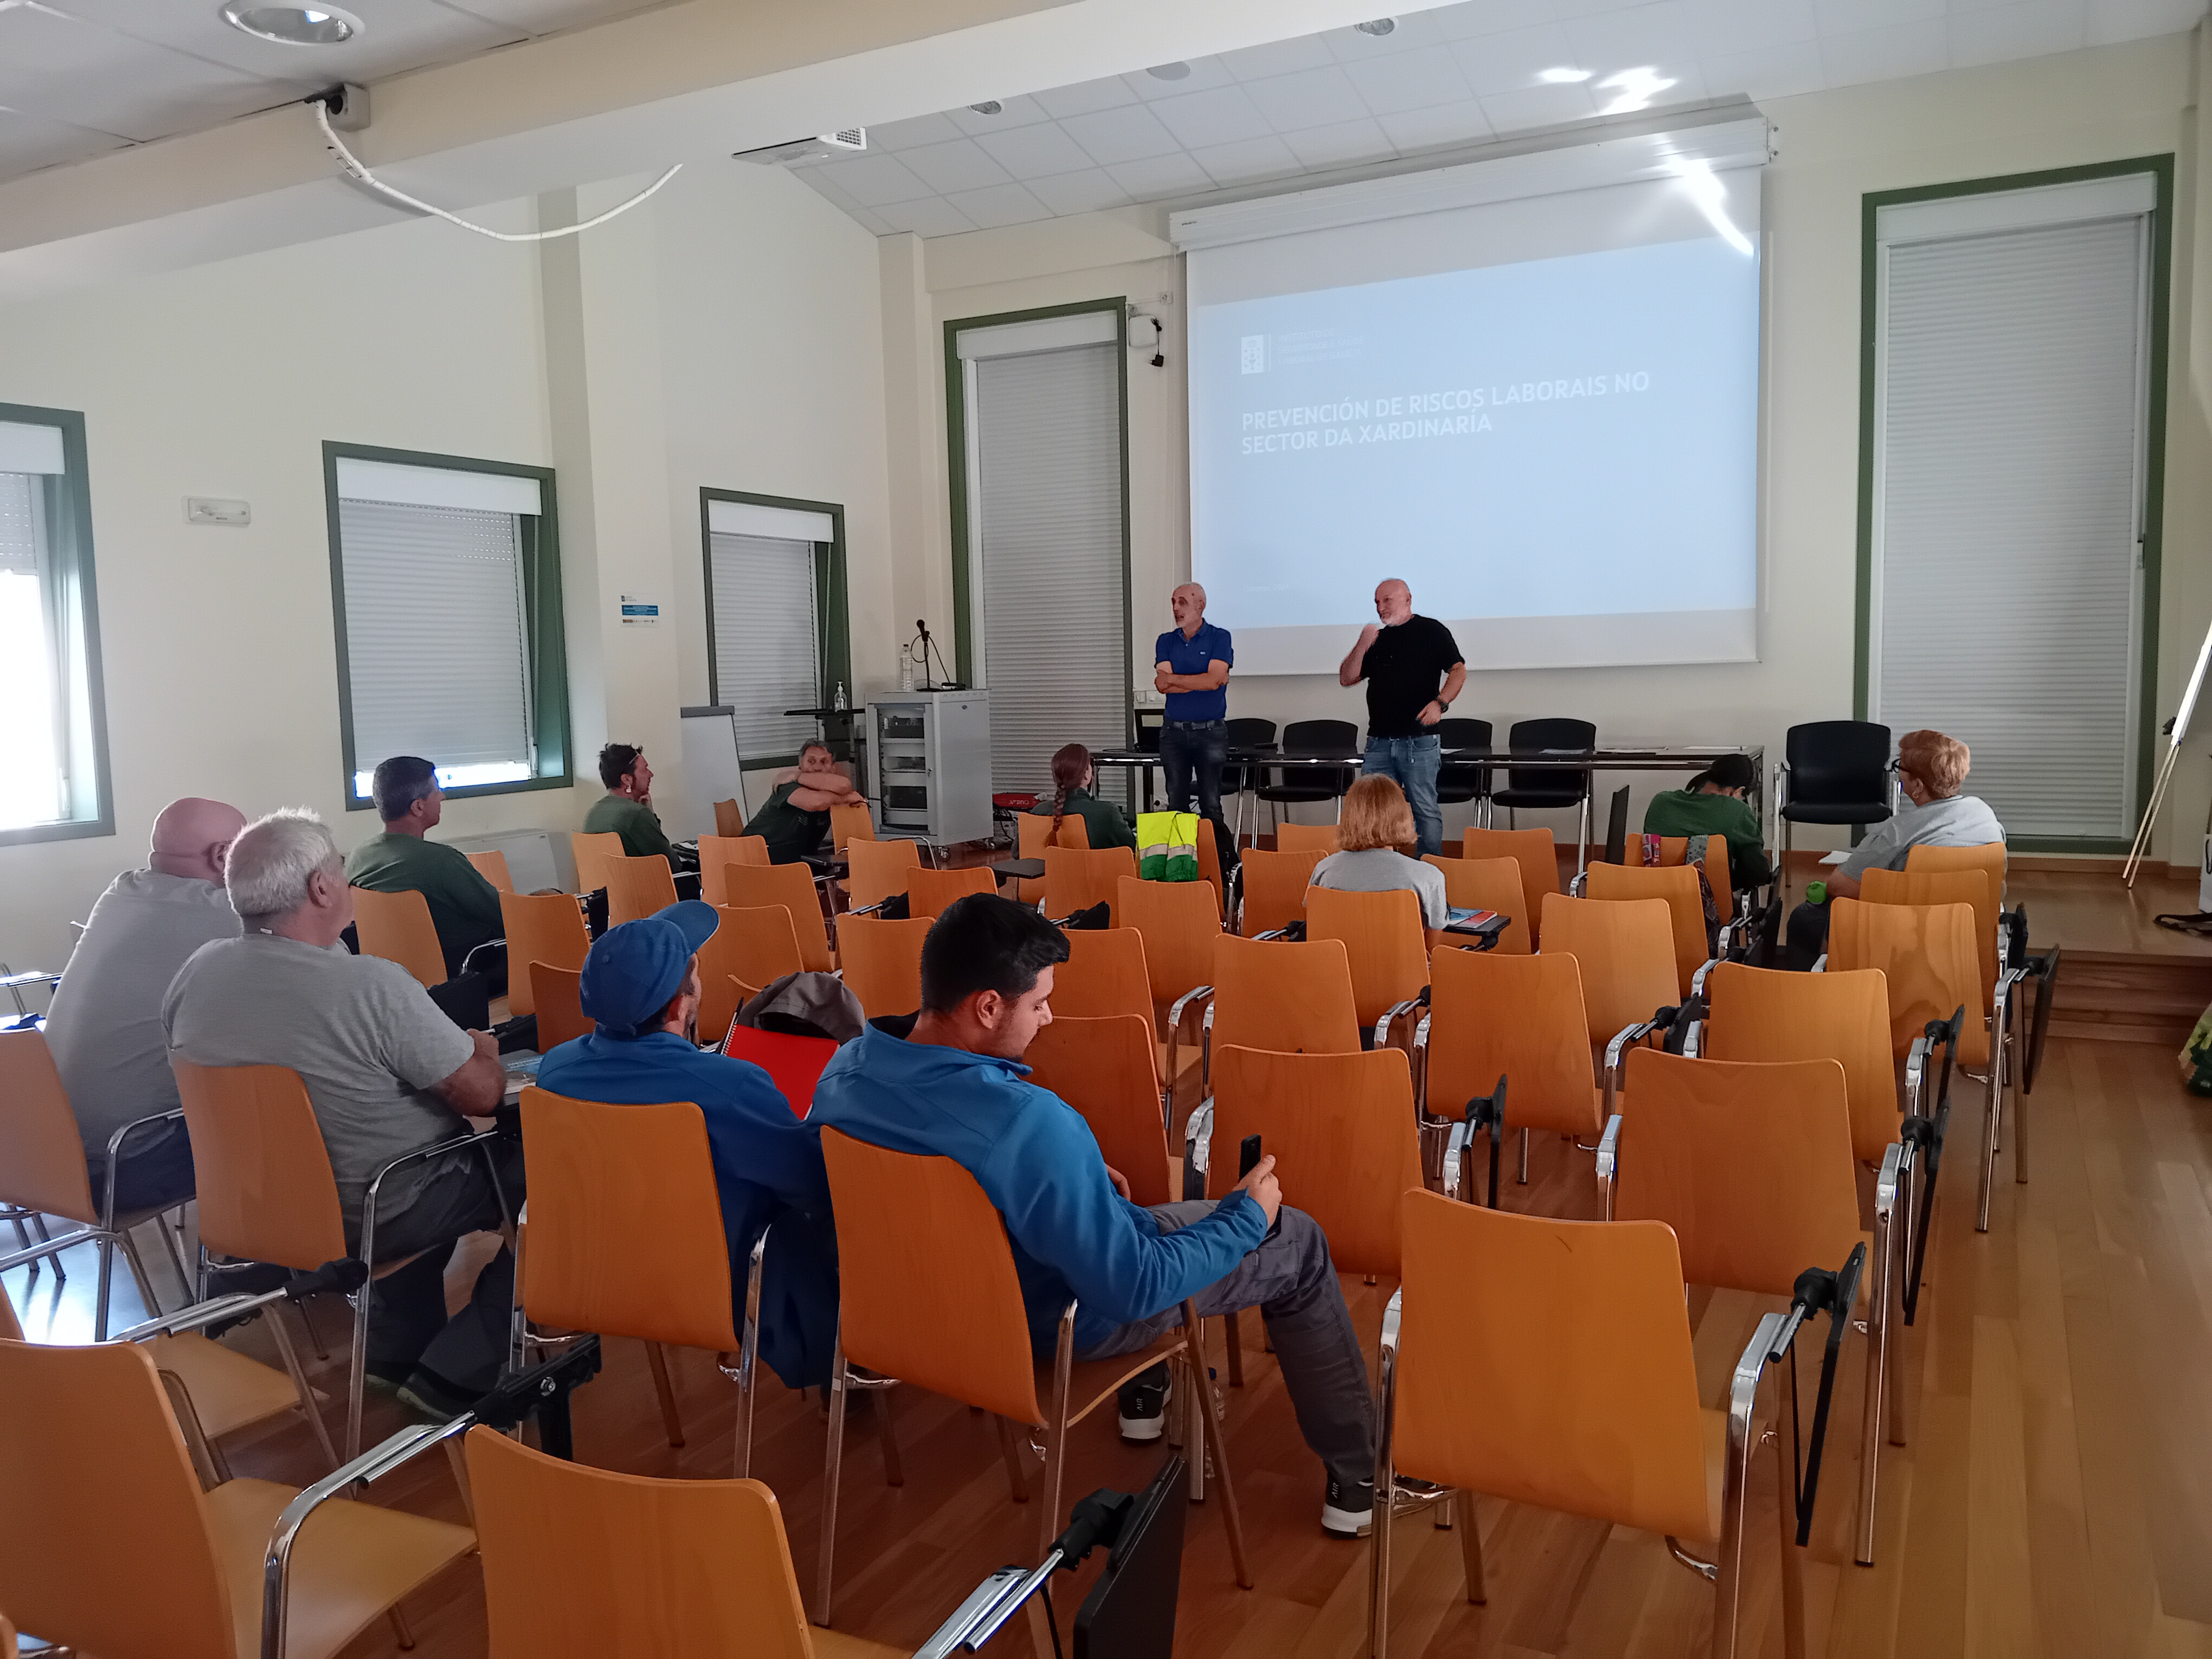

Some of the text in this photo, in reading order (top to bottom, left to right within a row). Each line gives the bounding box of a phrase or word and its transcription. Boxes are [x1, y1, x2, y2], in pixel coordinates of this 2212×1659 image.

[1242, 371, 1649, 432] PREVENCIÓN DE RISCOS LABORAIS NO
[1242, 408, 1493, 454] SECTOR DA XARDINARÍA
